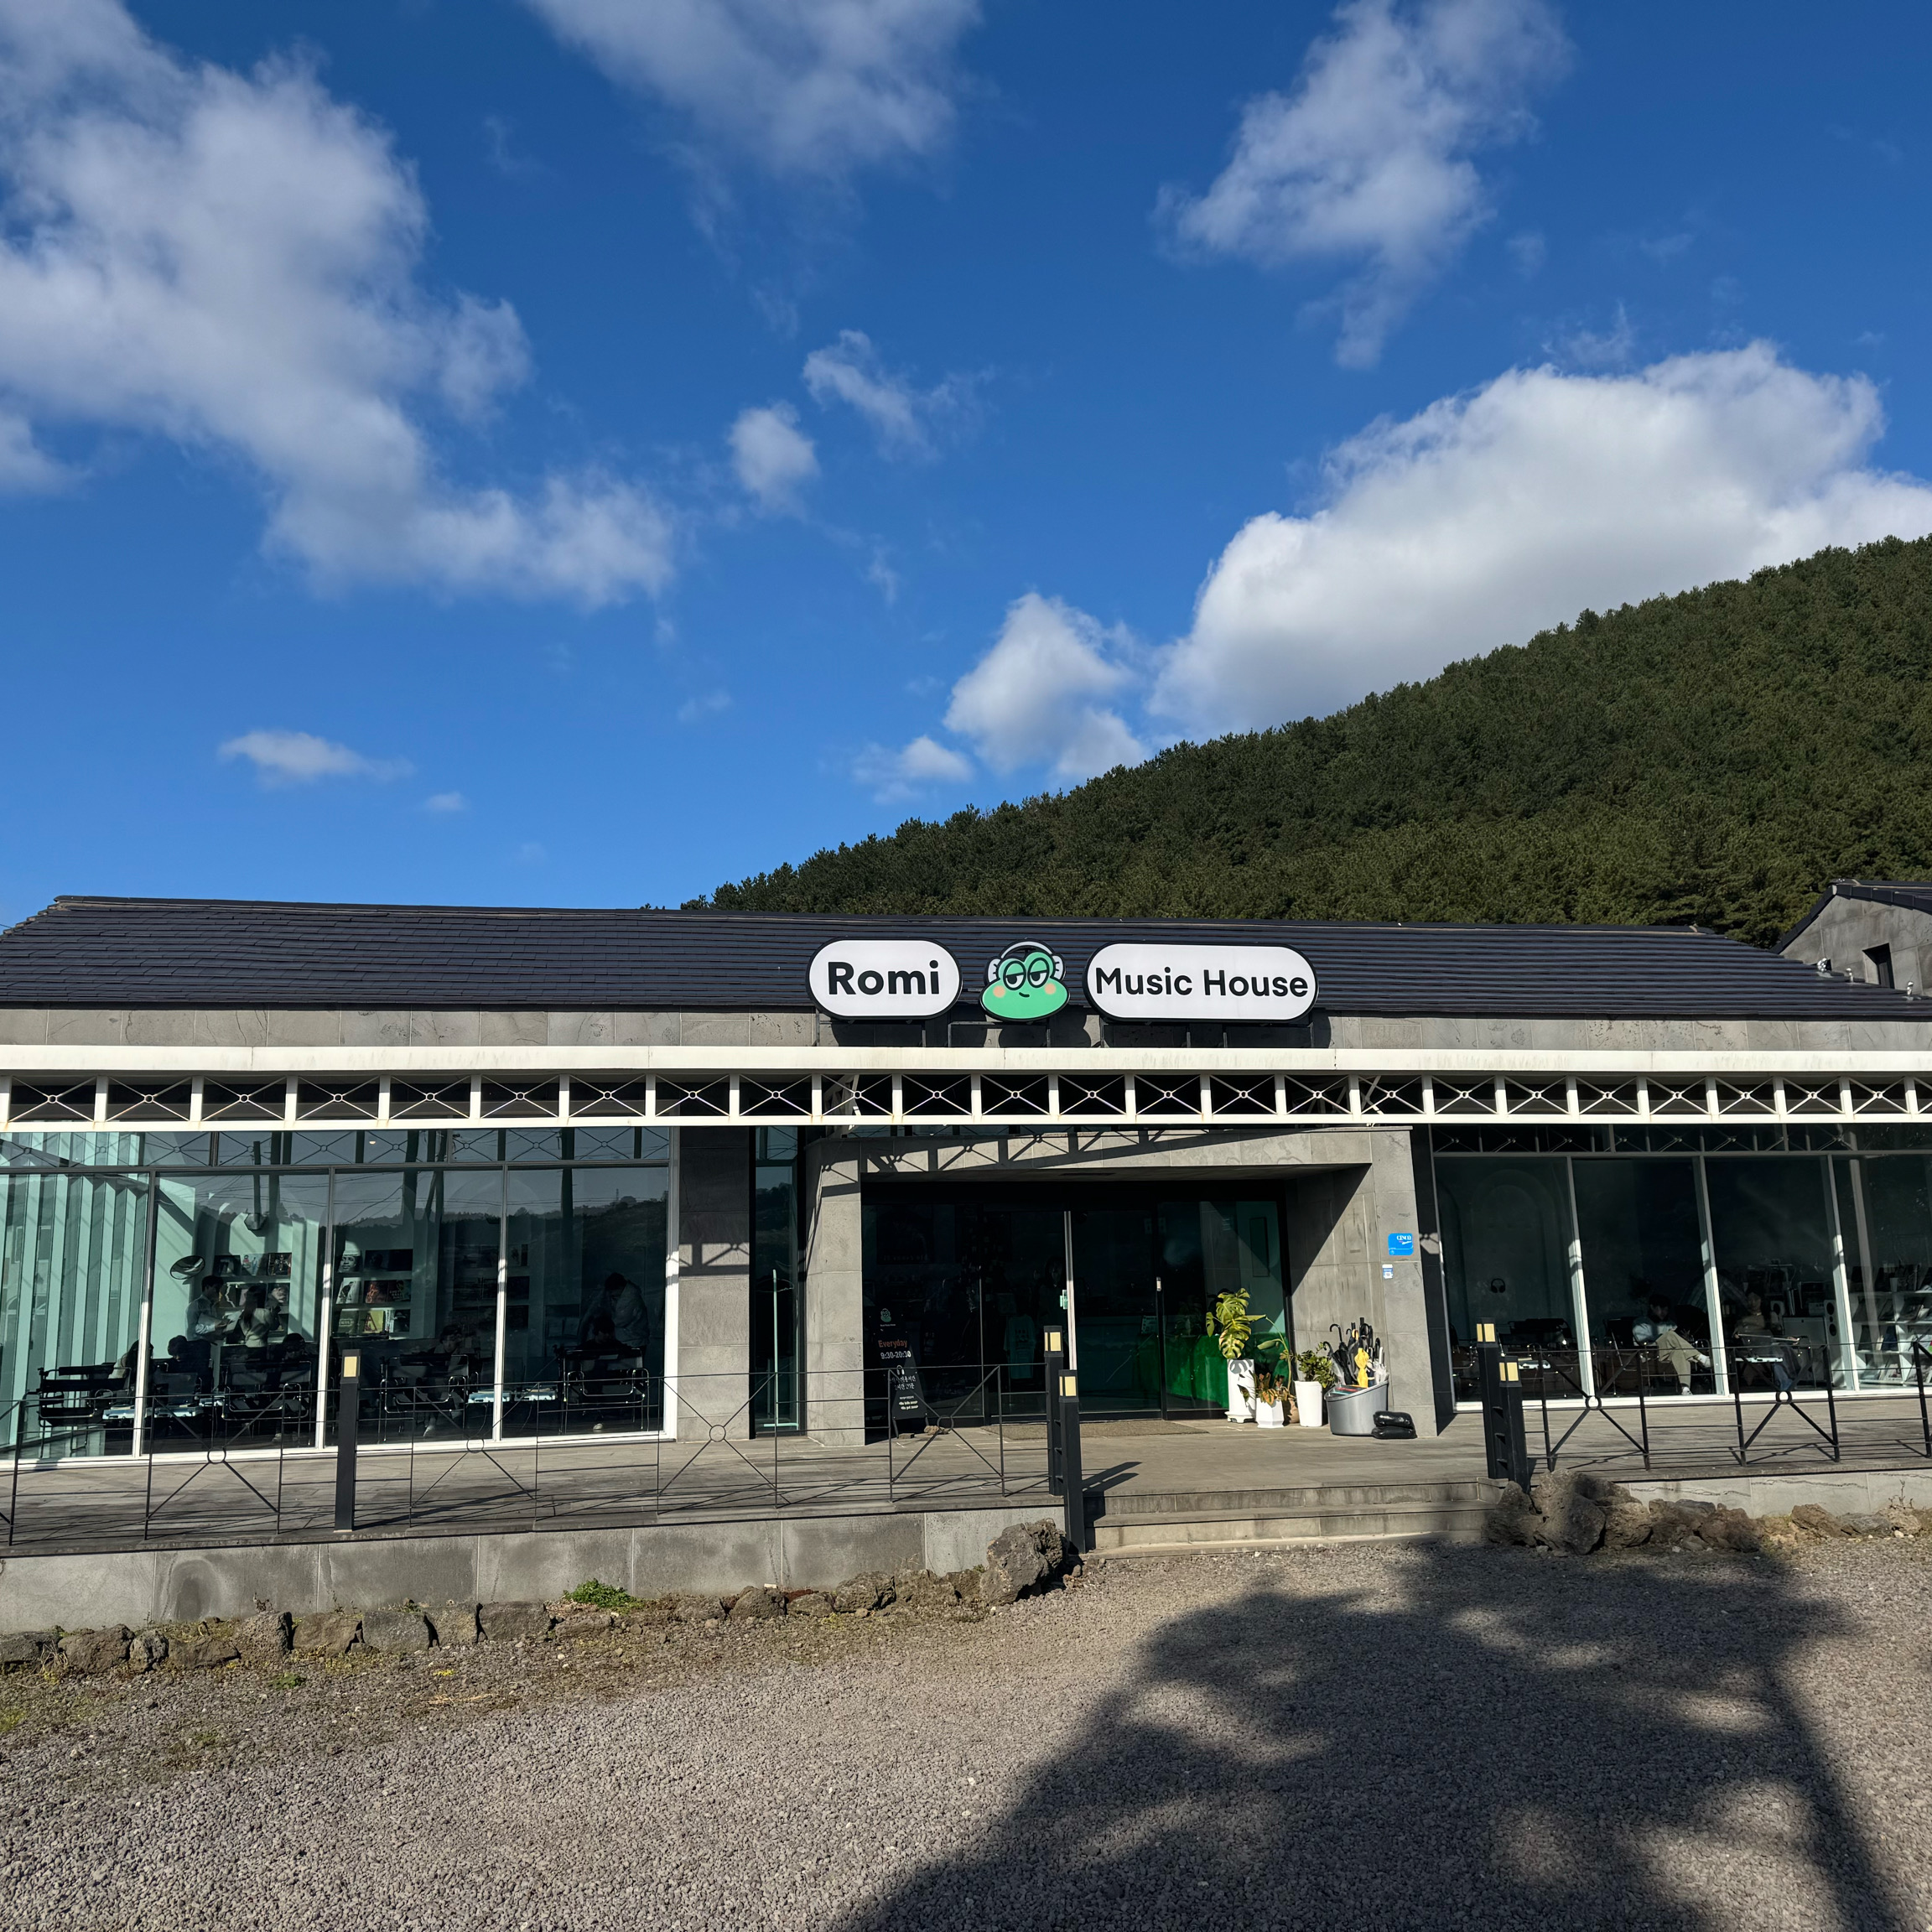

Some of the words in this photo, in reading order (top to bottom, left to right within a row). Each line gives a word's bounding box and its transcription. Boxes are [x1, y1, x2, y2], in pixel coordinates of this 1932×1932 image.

[828, 959, 940, 995] Romi
[1095, 966, 1193, 995] Music
[1203, 969, 1309, 998] House
[878, 1339, 908, 1348] Everyday
[880, 1350, 911, 1359] 9:30-20:30
